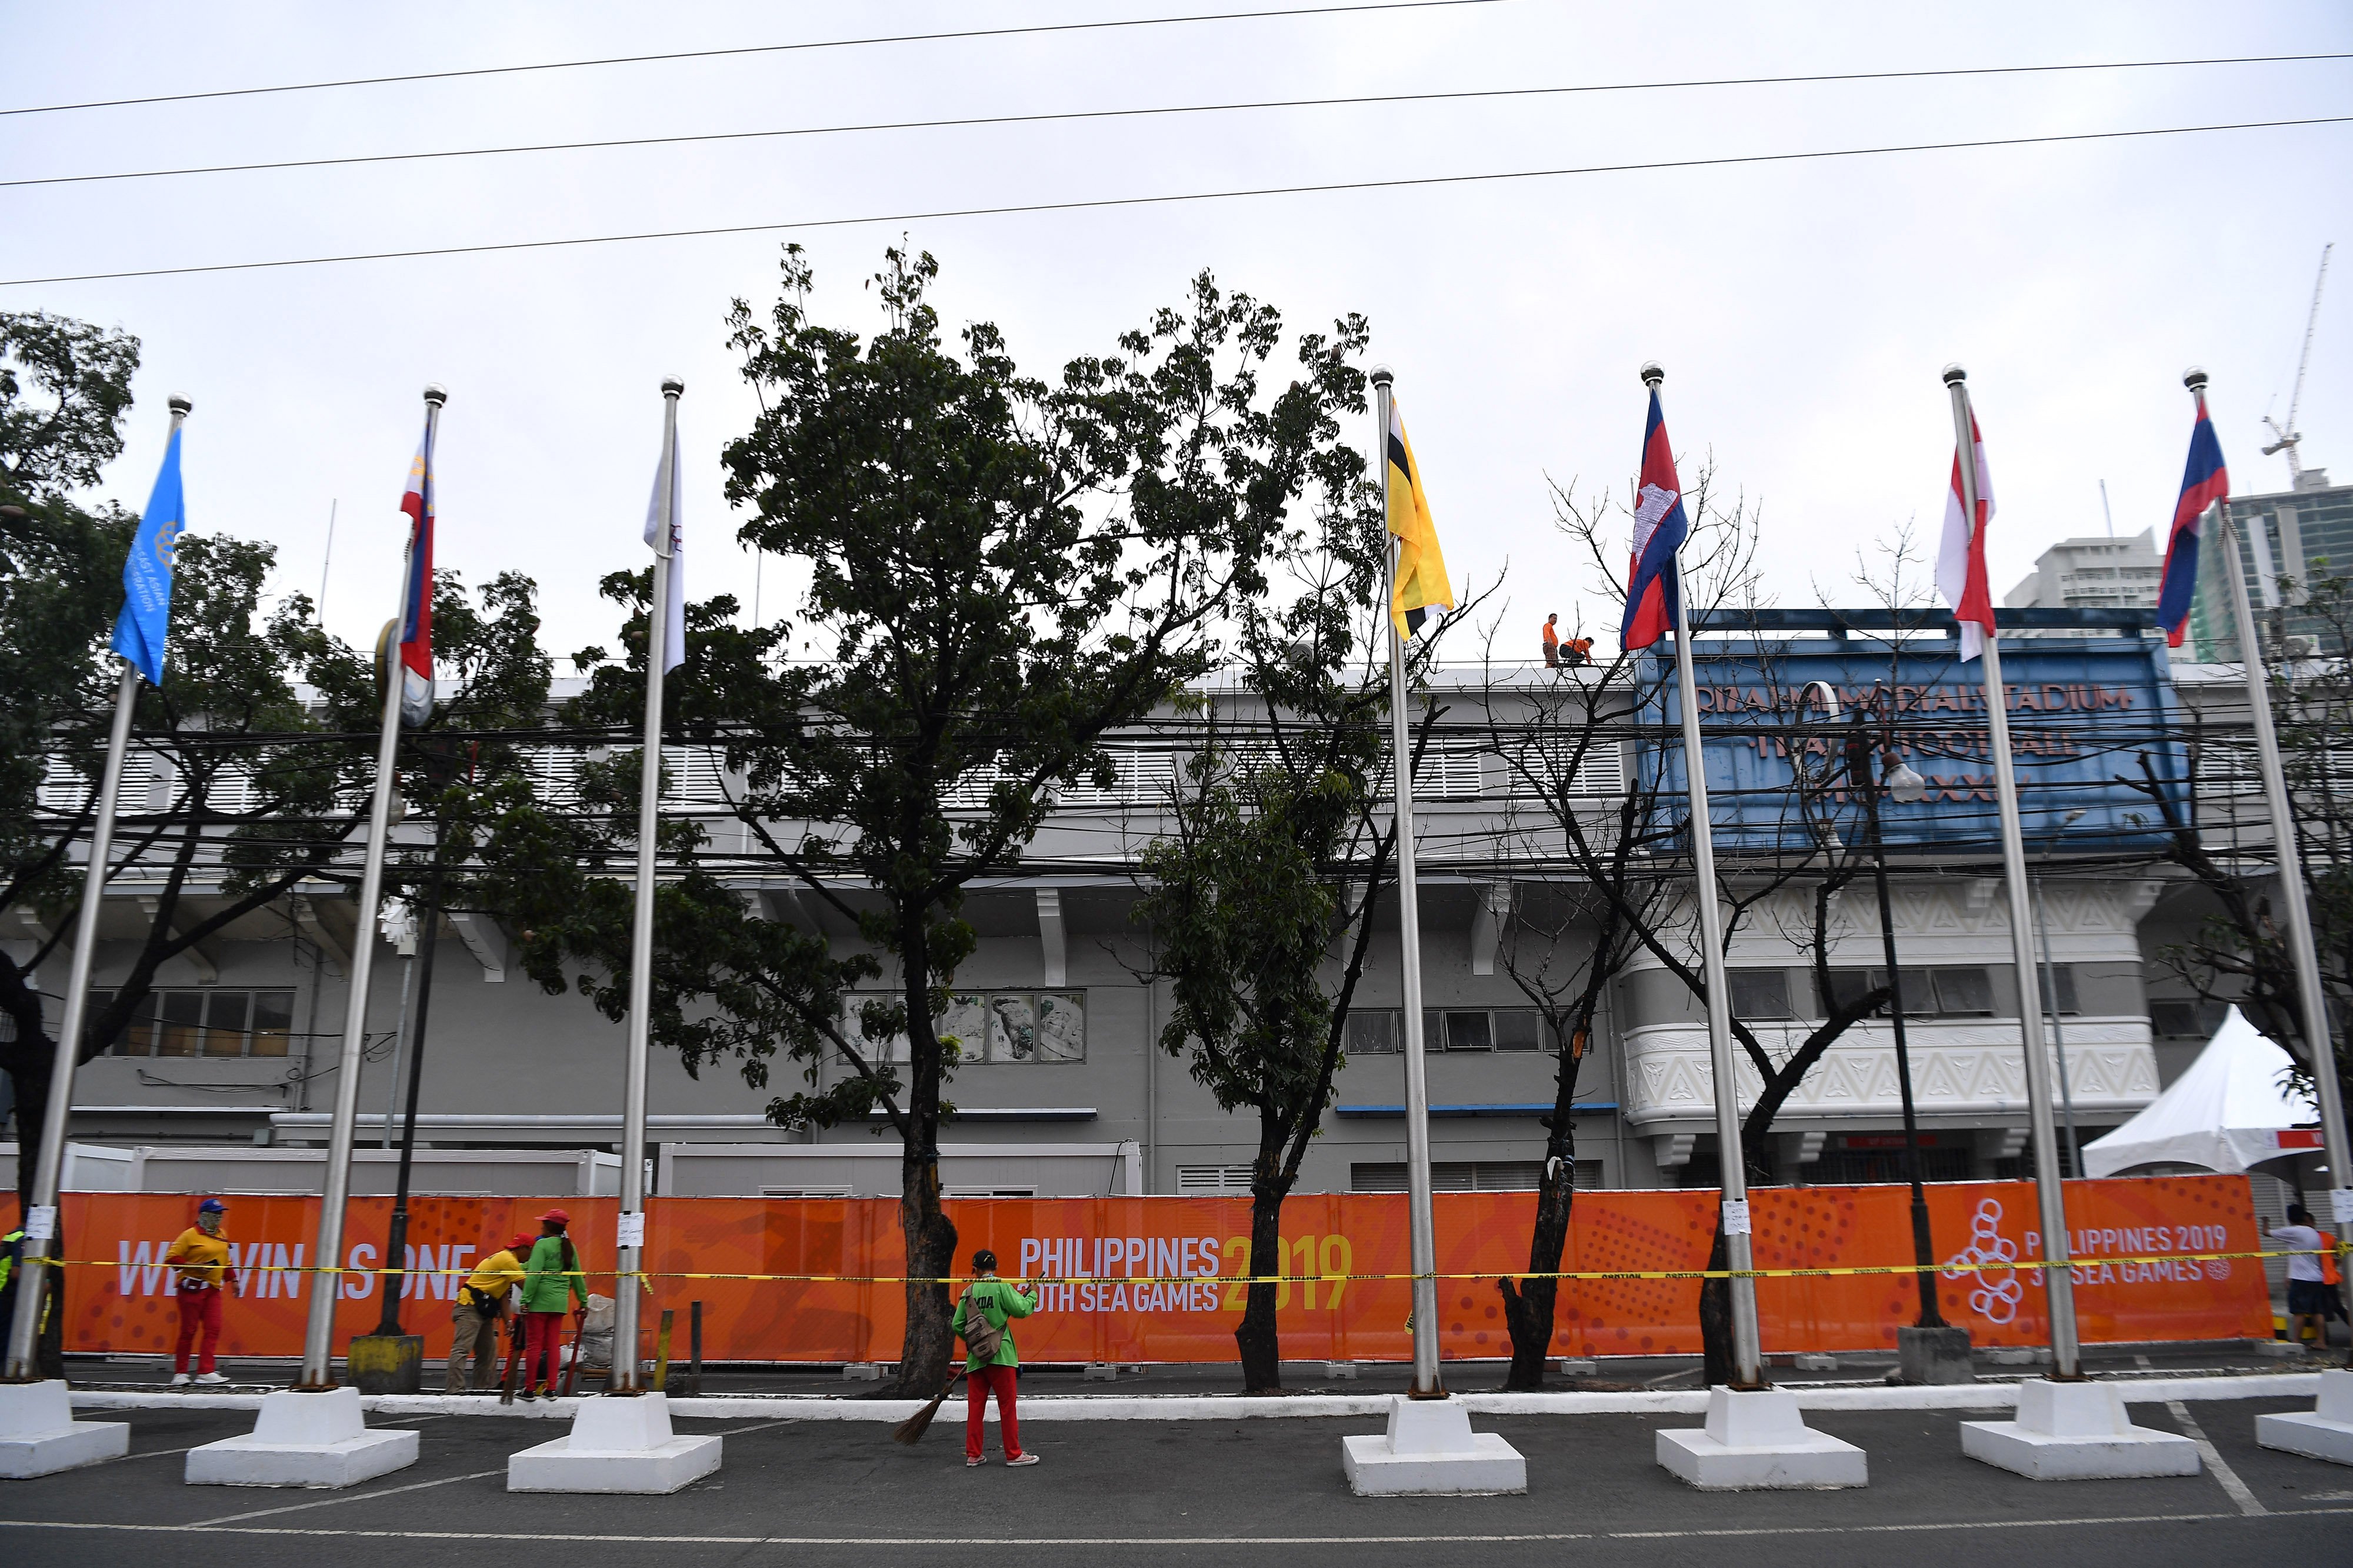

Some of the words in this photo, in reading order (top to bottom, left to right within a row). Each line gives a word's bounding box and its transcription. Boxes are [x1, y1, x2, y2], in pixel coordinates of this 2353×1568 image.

[2024, 1226, 2172, 1256] PLIPPINES
[2175, 1224, 2227, 1251] 2019
[1020, 1237, 1219, 1277] PHILIPPINES
[2071, 1264, 2116, 1285] SEA
[2120, 1260, 2203, 1285] GAMES
[1080, 1283, 1129, 1312] SEA
[1134, 1283, 1219, 1312] GAMES
